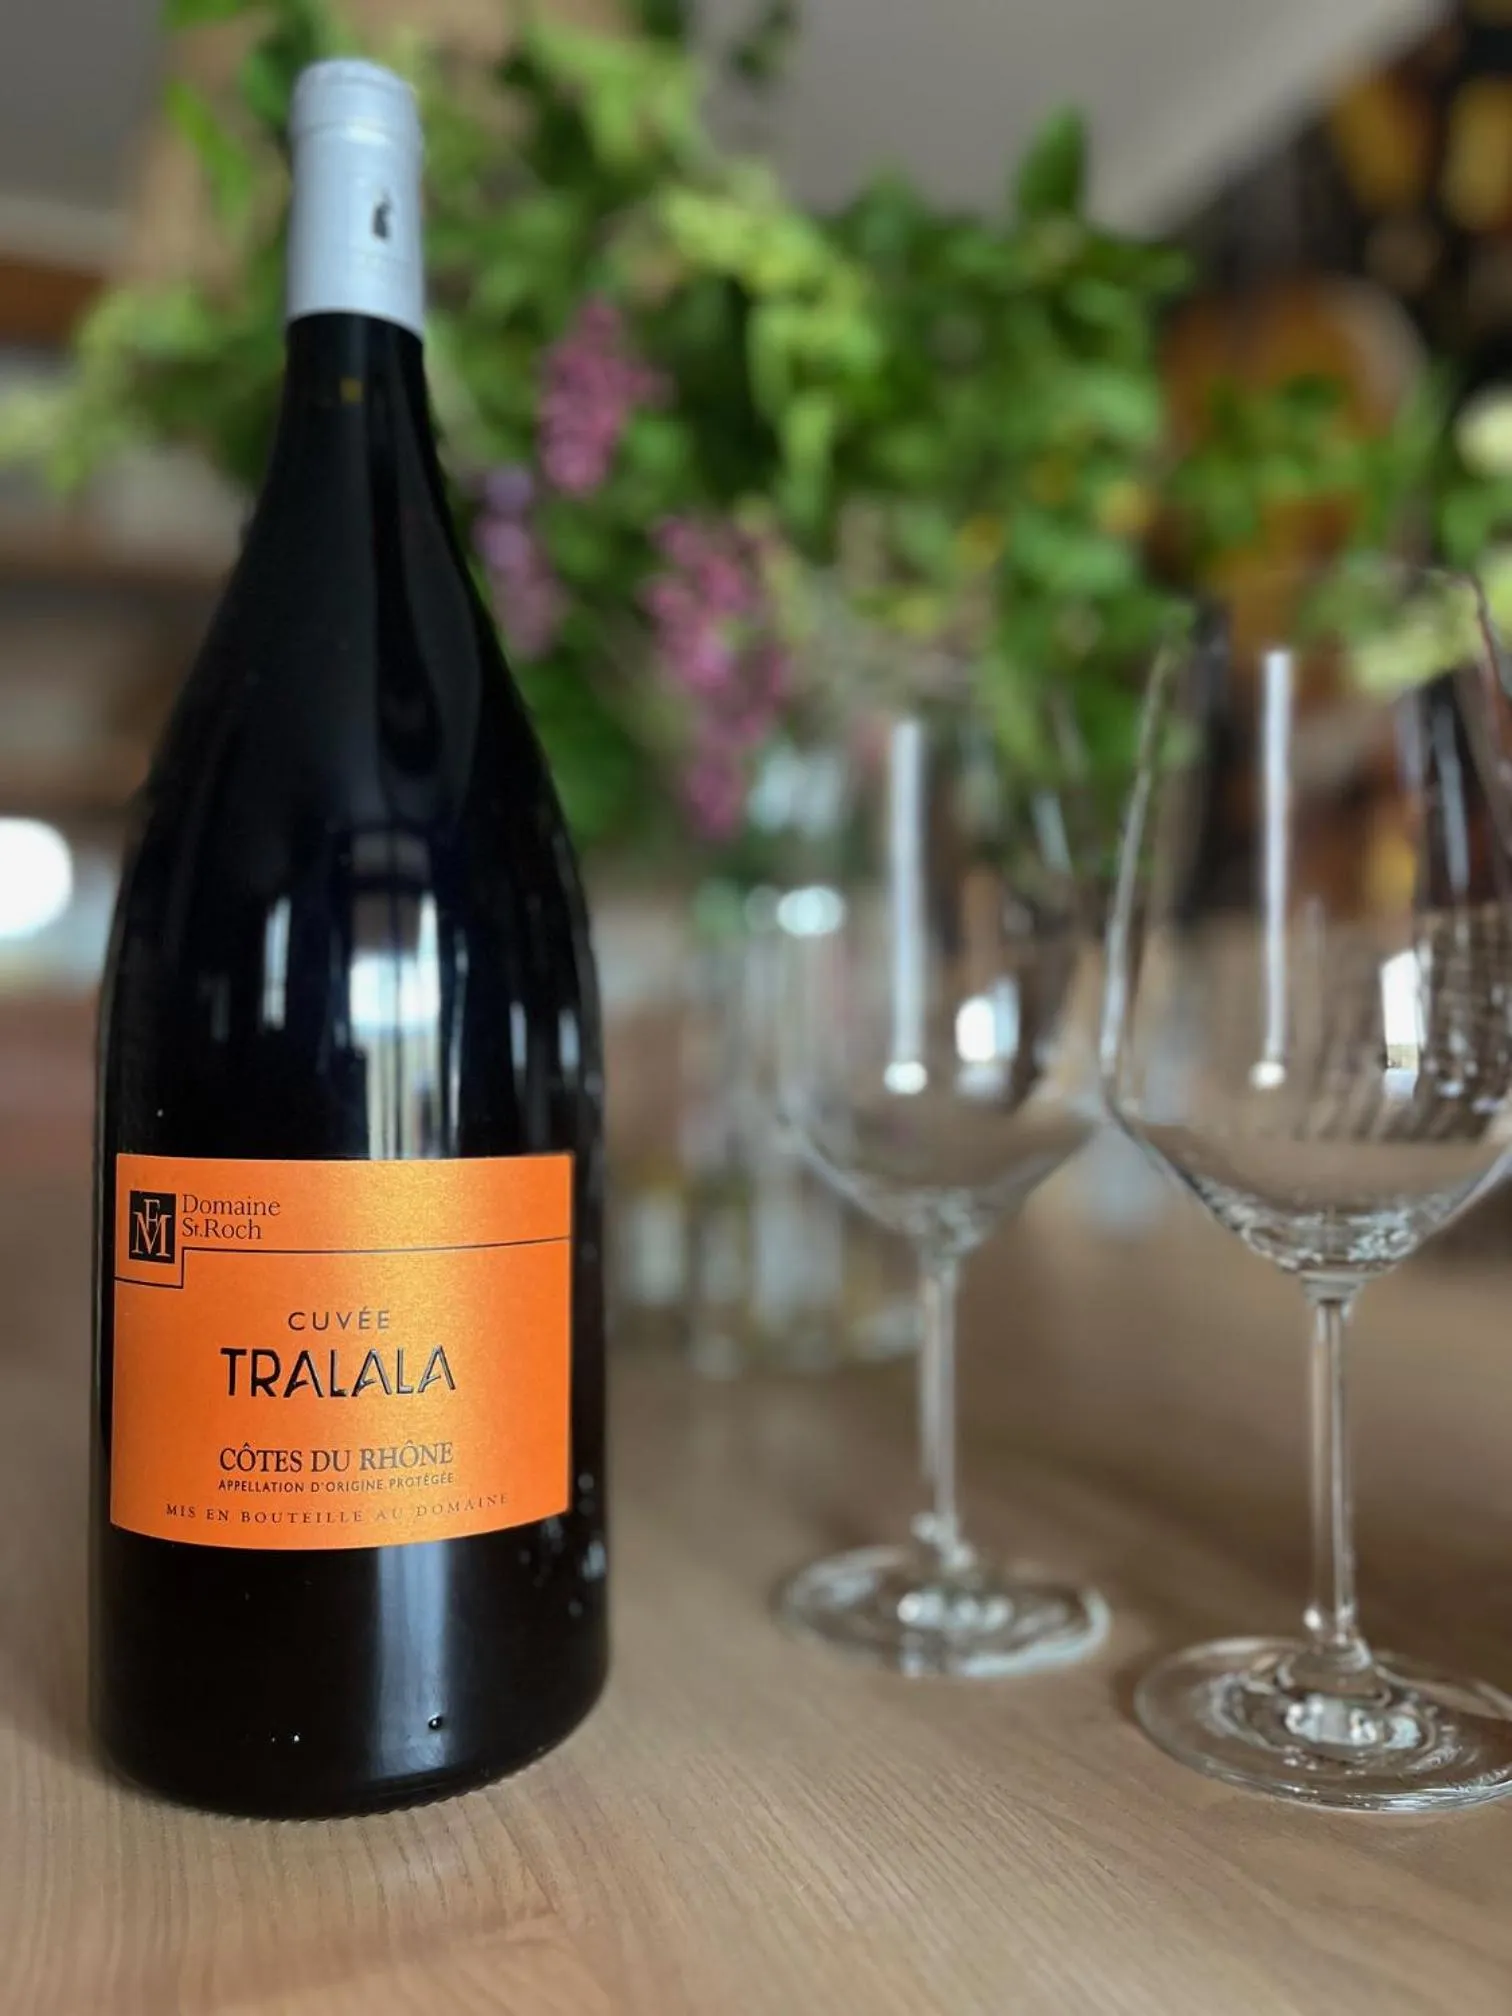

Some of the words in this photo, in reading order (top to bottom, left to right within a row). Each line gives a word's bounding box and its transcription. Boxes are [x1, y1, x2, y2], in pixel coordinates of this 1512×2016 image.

[181, 1194, 281, 1216] Domaine
[288, 1306, 391, 1331] CUVÉE
[220, 1344, 456, 1398] TRALALA
[219, 1442, 303, 1473] CÔTES
[311, 1449, 351, 1473] DU
[359, 1439, 454, 1471] RHÔNE
[218, 1479, 304, 1493] APPELLATION
[311, 1479, 383, 1493] D'ORIGINE
[389, 1472, 454, 1489] PROTÉGÉE
[166, 1503, 196, 1518] MIS
[206, 1508, 229, 1521] EN
[241, 1510, 364, 1524] BOUTEILLE
[376, 1508, 405, 1521] AU
[416, 1492, 508, 1517] DOMAINE
